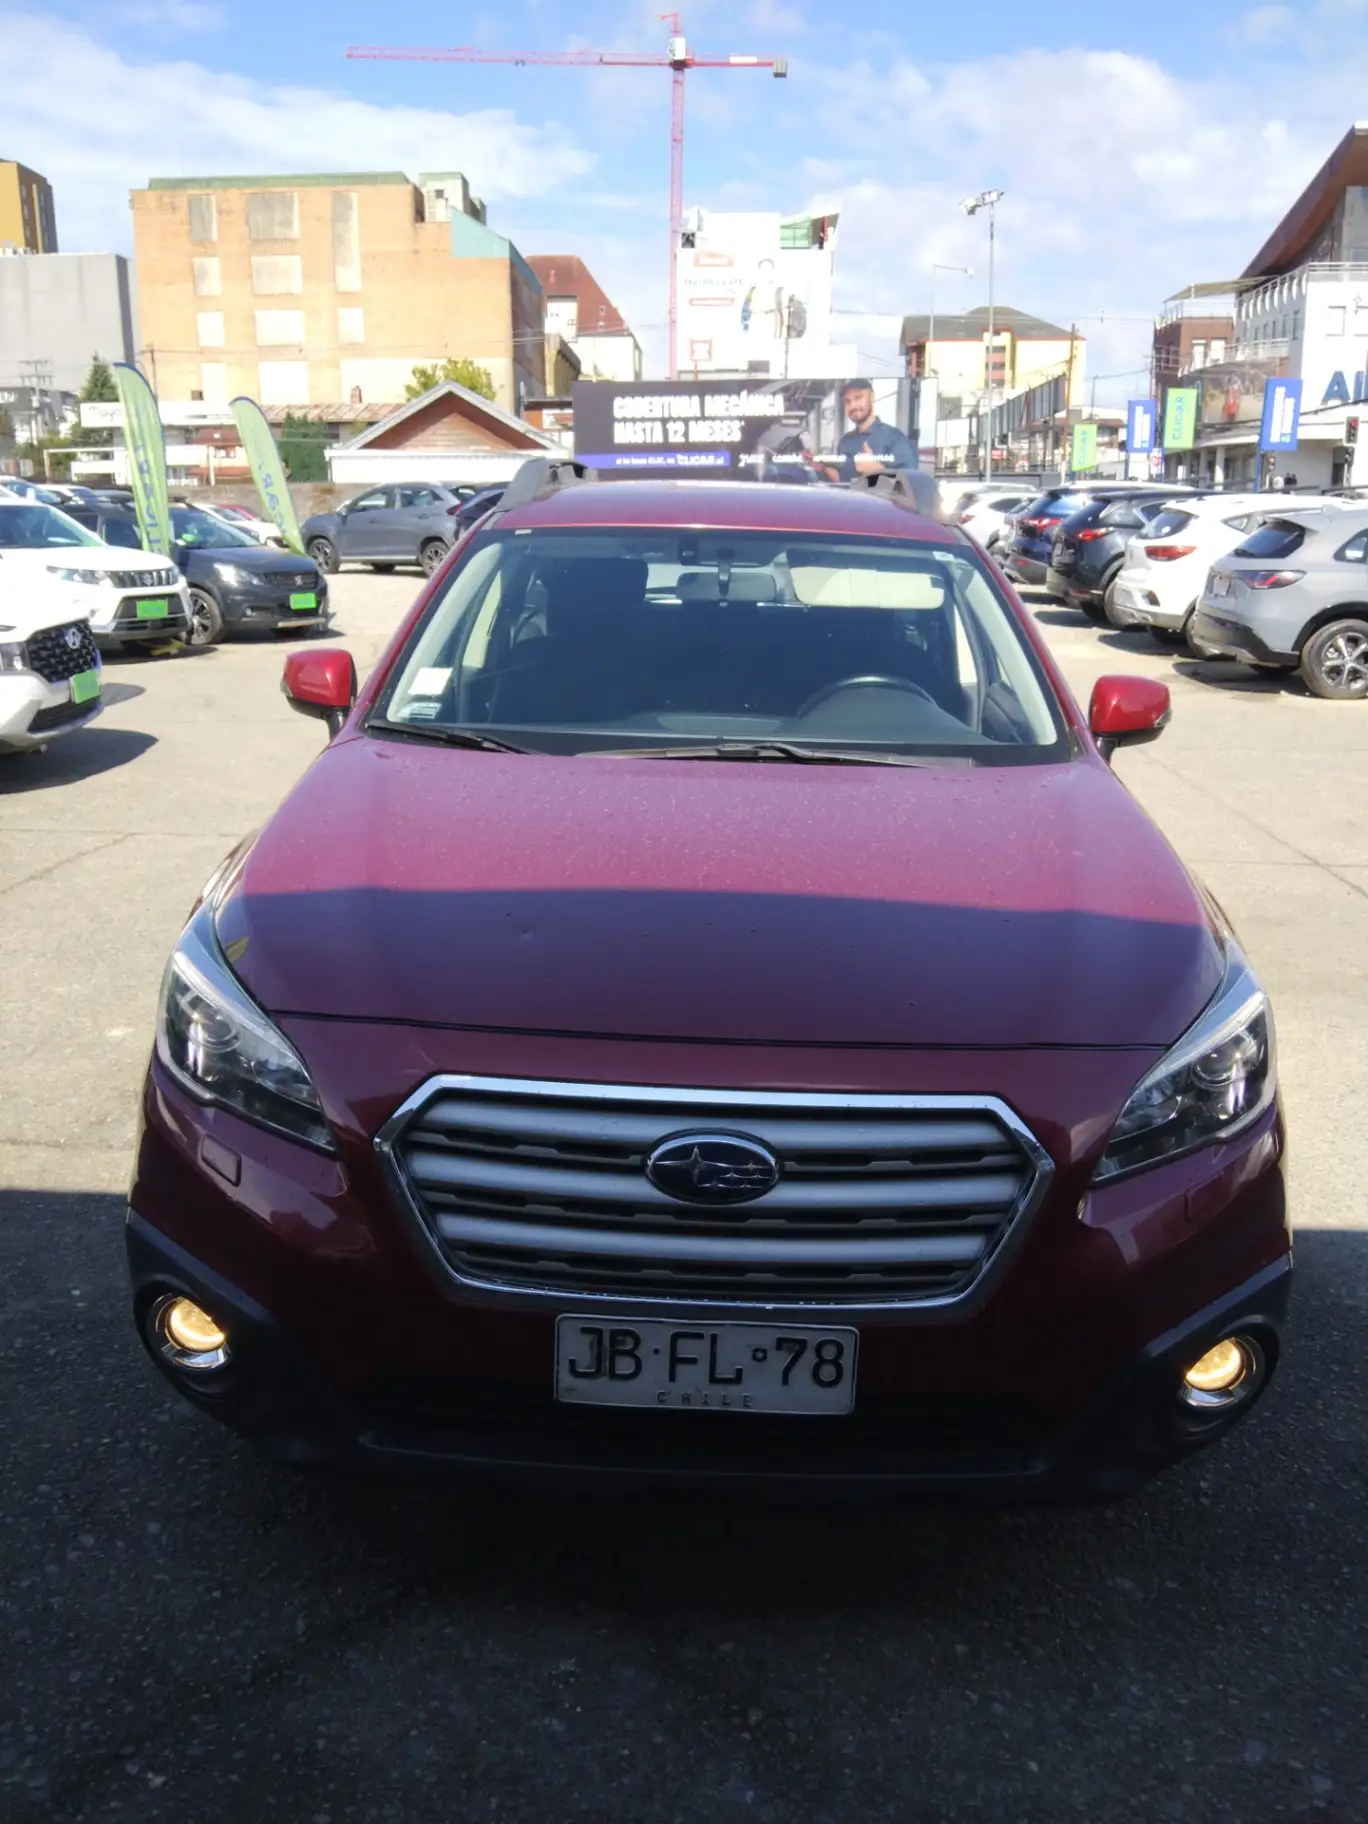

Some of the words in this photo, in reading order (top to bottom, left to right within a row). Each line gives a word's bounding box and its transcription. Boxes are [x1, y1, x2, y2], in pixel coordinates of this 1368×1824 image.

[1321, 370, 1368, 406] AI
[612, 396, 702, 419] COBERTURA
[613, 421, 664, 444] HASTA
[666, 420, 686, 443] 12
[656, 1388, 754, 1408] CHILE
